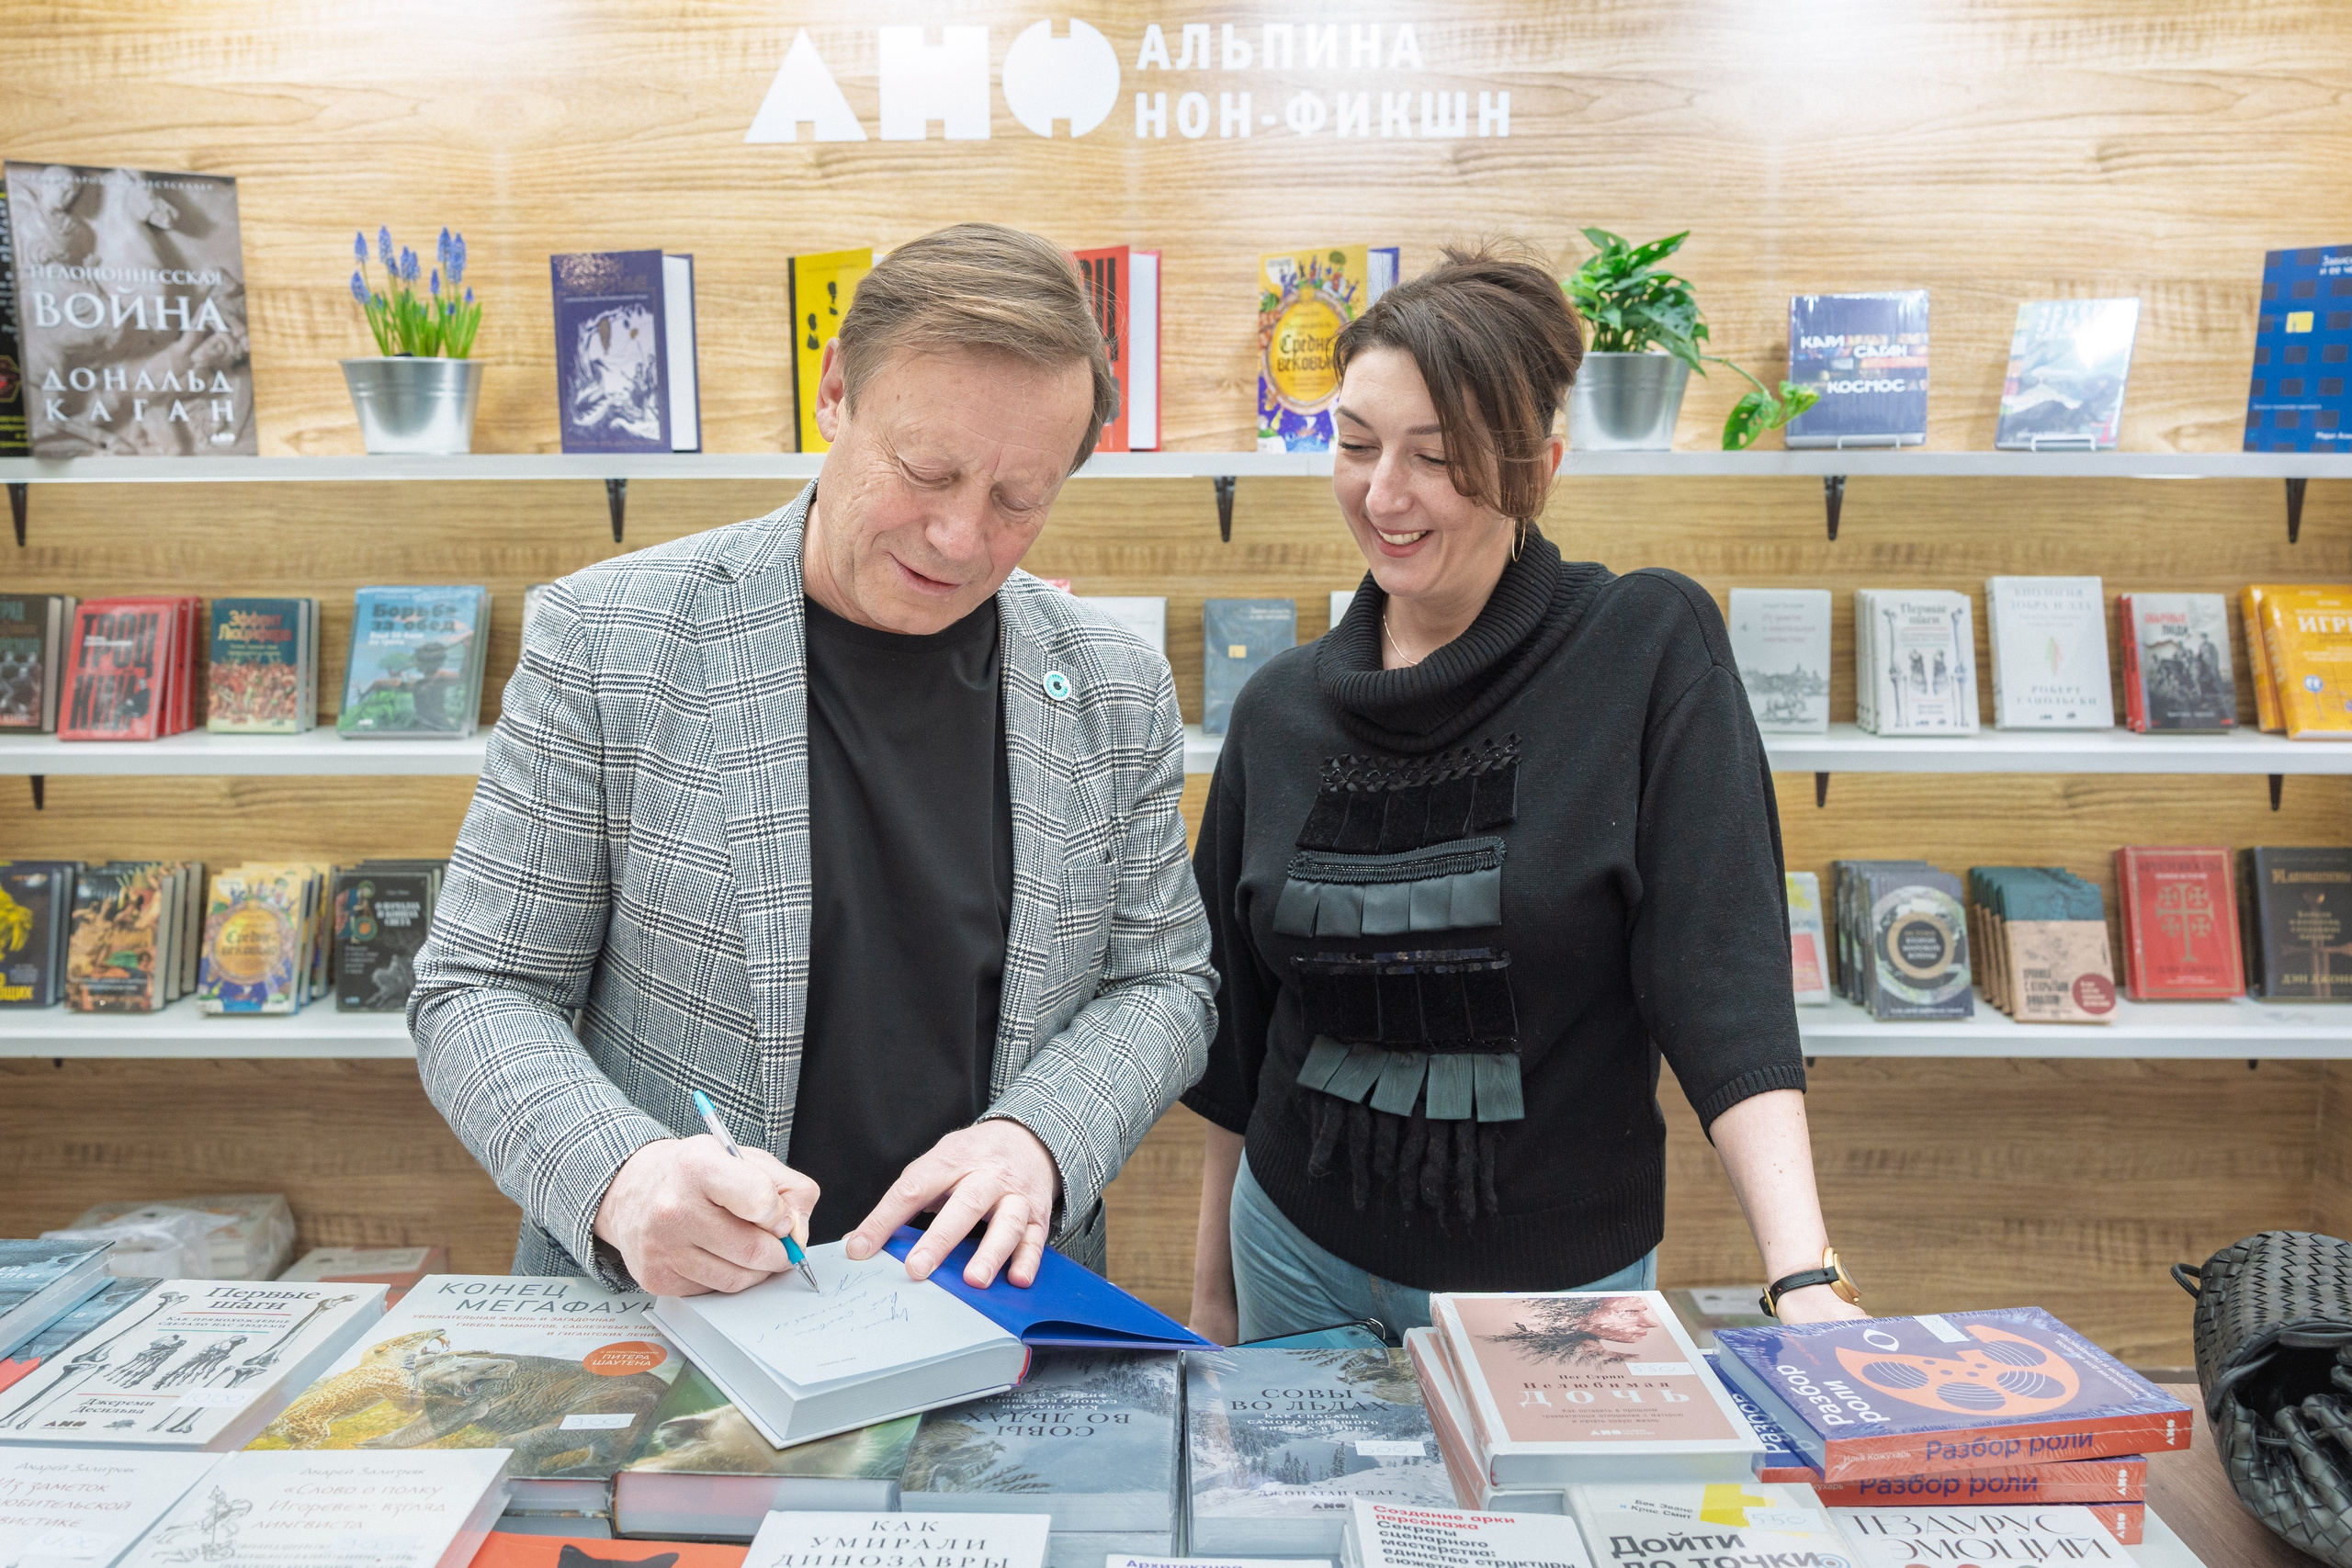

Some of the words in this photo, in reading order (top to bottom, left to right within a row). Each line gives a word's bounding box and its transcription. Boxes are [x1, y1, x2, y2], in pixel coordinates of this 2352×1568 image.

[1136, 24, 1424, 70] АЛЬПИНА
[1136, 91, 1510, 139] НОН-ФИКШН
[34, 287, 230, 333] ВОЙНА
[1853, 344, 1908, 359] САГАН
[42, 367, 233, 393] ДОНАЛЬД
[1826, 378, 1906, 394] КОСМОС
[46, 398, 234, 423] КАГАН
[204, 1287, 321, 1302] Первые
[438, 1282, 570, 1298] КОНЕЦ
[207, 1301, 288, 1310] шаги
[456, 1299, 654, 1314] МЕГАФАУН
[1261, 1388, 1354, 1399] СОВЫ
[1523, 1382, 1670, 1390] Нелюбимая
[80, 1398, 156, 1406] Джереми
[1519, 1389, 1690, 1408] ДОЧЬ
[1776, 1365, 1855, 1426] Разбор
[1823, 1381, 1891, 1423] роли
[70, 1405, 145, 1415] Десильва
[1230, 1400, 1273, 1411] ВО
[1285, 1401, 1390, 1413] ЛЬДАХ
[965, 1411, 1074, 1424] ЛЬДАХ
[1087, 1413, 1131, 1424] ВО
[997, 1426, 1095, 1438] СОВЫ
[1867, 1450, 1911, 1463] Кожухарь
[1926, 1437, 2021, 1461] Разбор
[2029, 1432, 2093, 1453] роли
[1257, 1489, 1348, 1498] ДЖОНАТАН
[1860, 1474, 1961, 1497] Разбор
[1969, 1474, 2038, 1496] роли
[0, 1497, 132, 1511] ЮБИТЕЛЬСКОЙ
[1631, 1505, 1658, 1514] Крис
[1663, 1510, 1692, 1519] Смит
[1635, 1499, 1656, 1507] Бек
[1659, 1503, 1693, 1514] Эванс
[1373, 1505, 1464, 1521] Создание
[1470, 1516, 1515, 1524] арки
[1375, 1514, 1479, 1530] персонажа
[871, 1520, 940, 1532] КАК
[1377, 1520, 1457, 1537] Секреты
[1842, 1513, 2073, 1535] ТЕЗАУРУС
[811, 1537, 988, 1551] УМИРАЛИ
[1379, 1529, 1488, 1548] сценарного
[1609, 1531, 1747, 1559] Дойти
[1381, 1540, 1497, 1557] мастерства:
[1383, 1548, 1469, 1565] единство
[1880, 1537, 2112, 1562] ЭМОЦИЙ
[771, 1553, 1011, 1568] ДИНОЗАВРЫ
